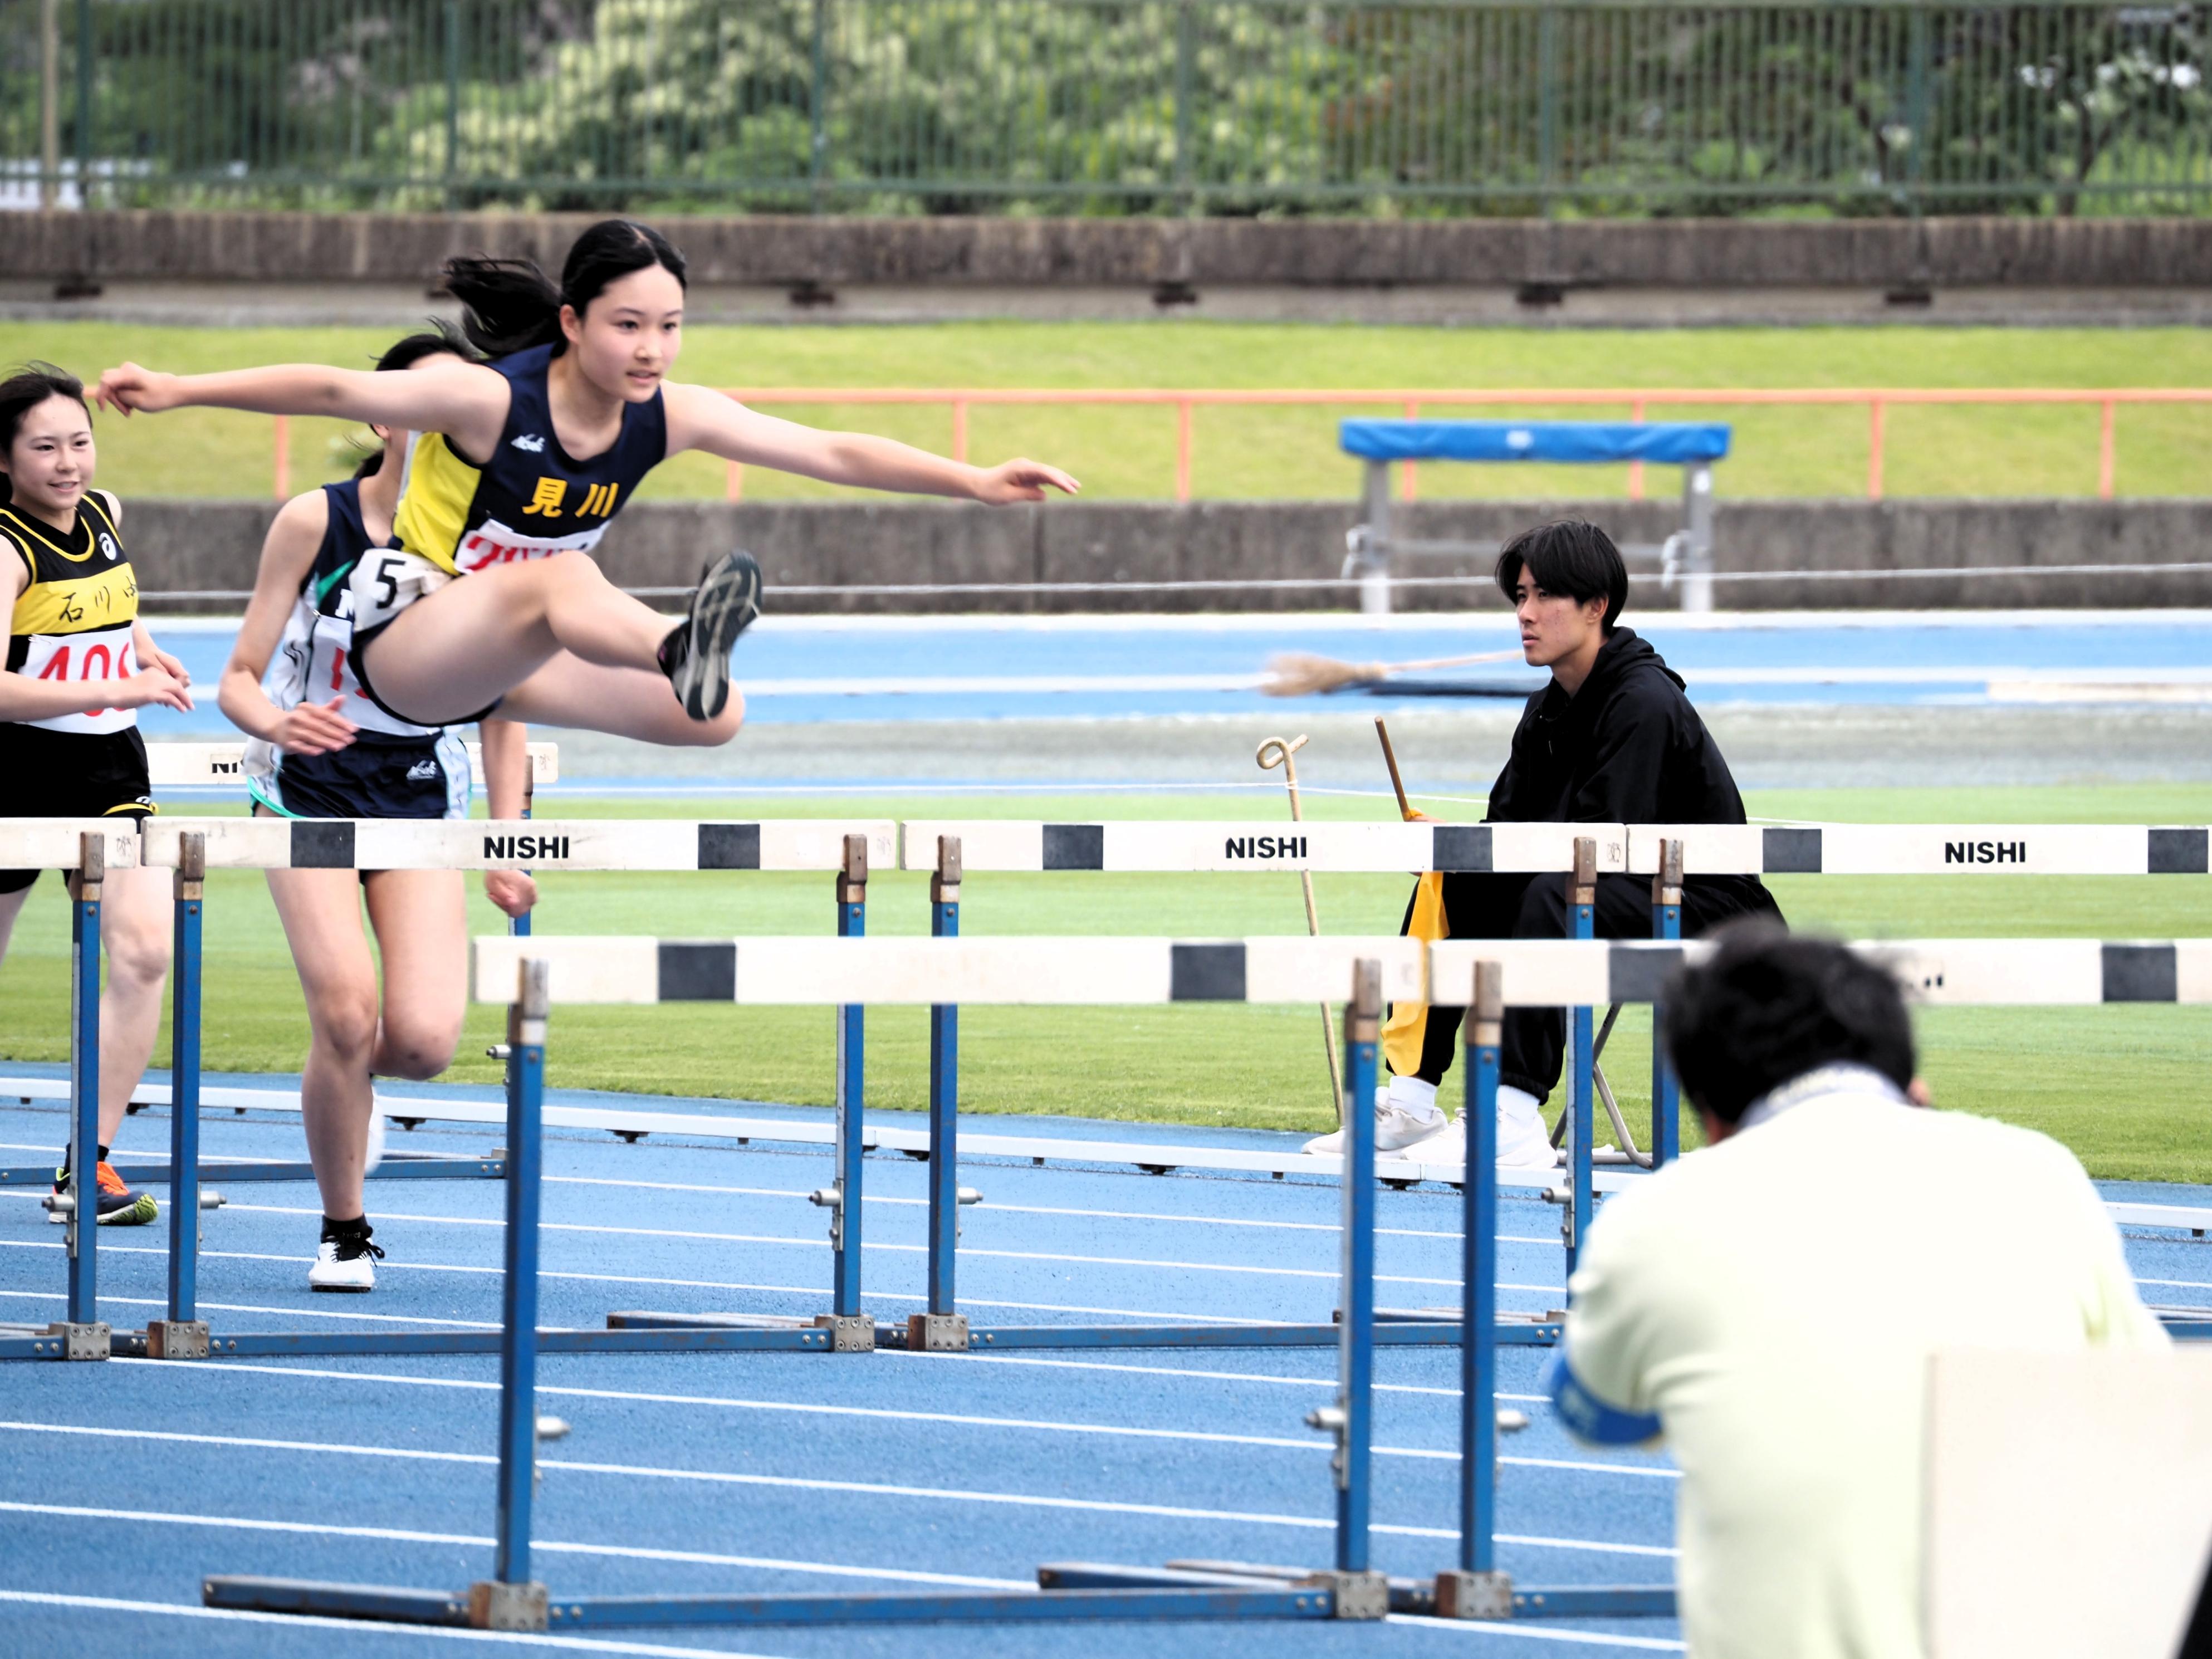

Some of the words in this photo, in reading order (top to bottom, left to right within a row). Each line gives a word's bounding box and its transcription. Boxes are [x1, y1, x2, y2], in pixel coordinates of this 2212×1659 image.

[522, 477, 619, 517] 見川
[375, 558, 406, 609] 5
[484, 836, 569, 859] NISHI
[1226, 836, 1306, 858] NISHI
[1945, 841, 2025, 863] NISHI
